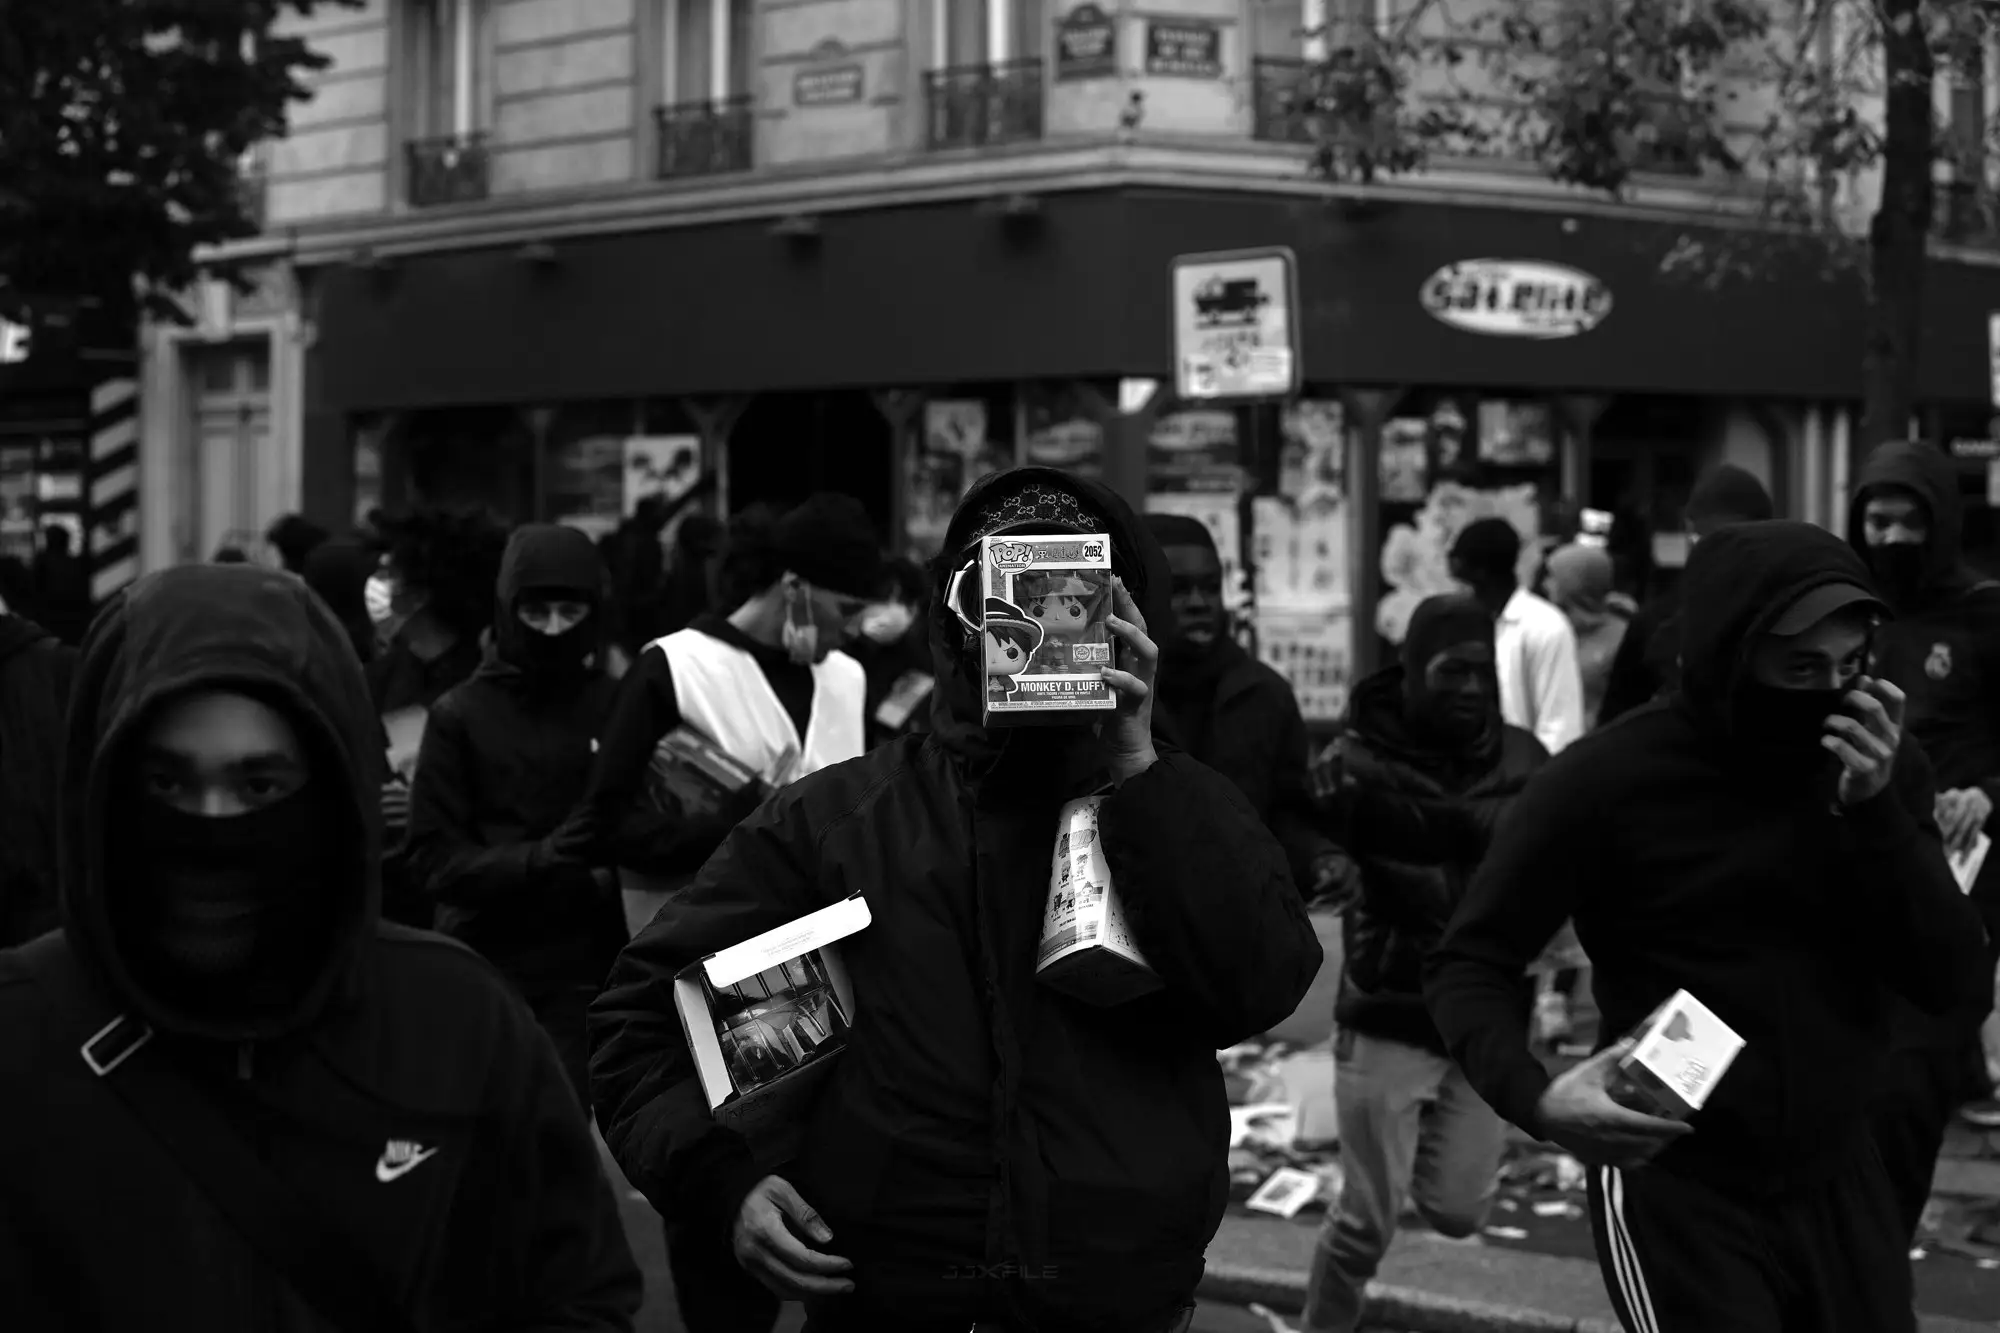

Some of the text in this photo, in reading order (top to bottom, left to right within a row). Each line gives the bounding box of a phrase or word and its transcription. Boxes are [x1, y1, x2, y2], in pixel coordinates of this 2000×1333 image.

[988, 543, 1033, 564] POP!
[1084, 545, 1102, 557] 2052
[1020, 681, 1106, 692] MONKEY D. LUFFY
